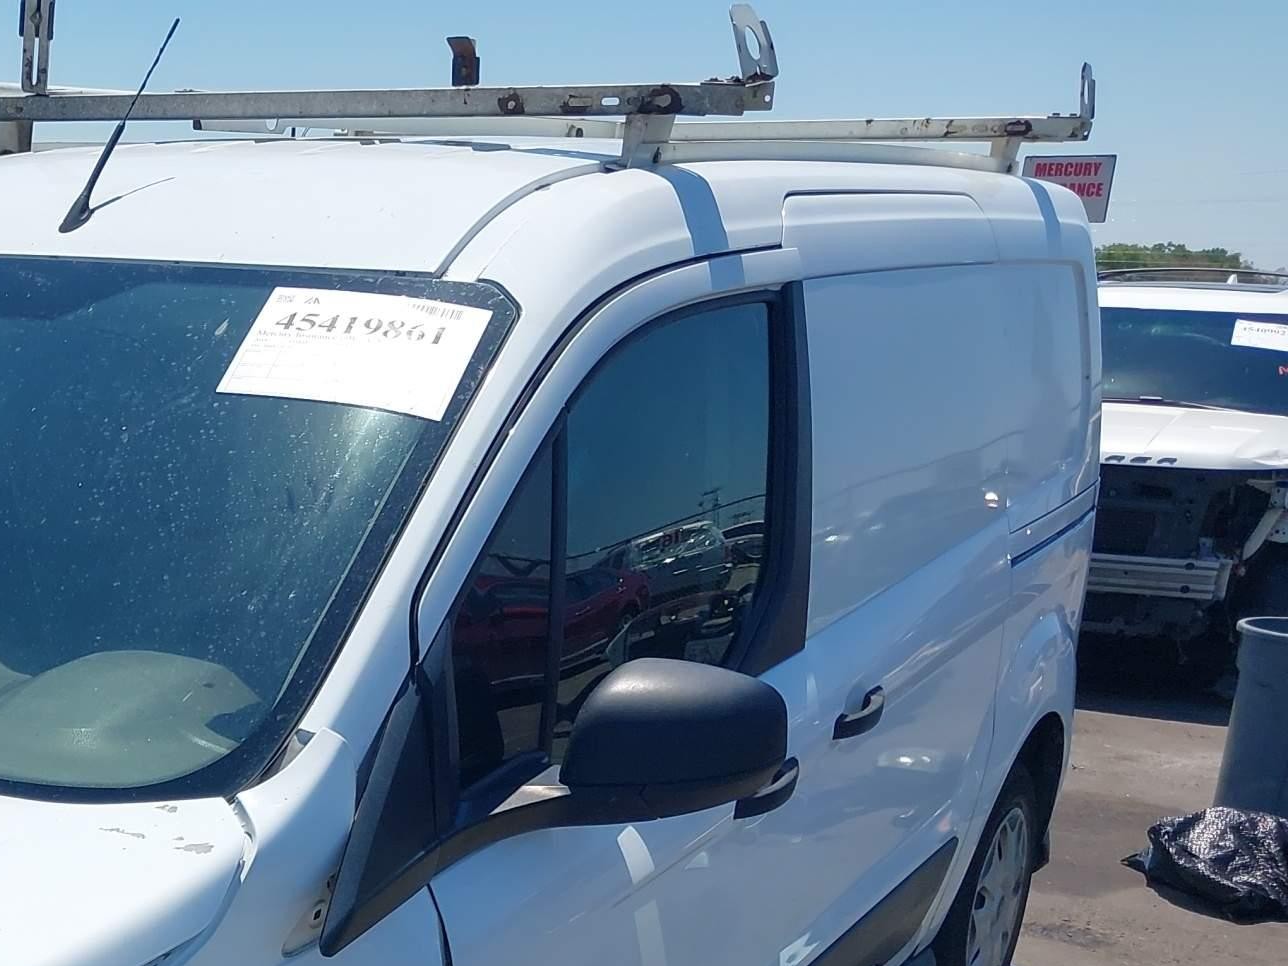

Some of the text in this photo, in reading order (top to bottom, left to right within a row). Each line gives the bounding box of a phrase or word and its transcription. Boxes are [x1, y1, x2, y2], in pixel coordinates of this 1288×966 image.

[1034, 162, 1103, 177] MERCURY
[1064, 182, 1104, 197] ANCE
[275, 312, 447, 345] 45419861
